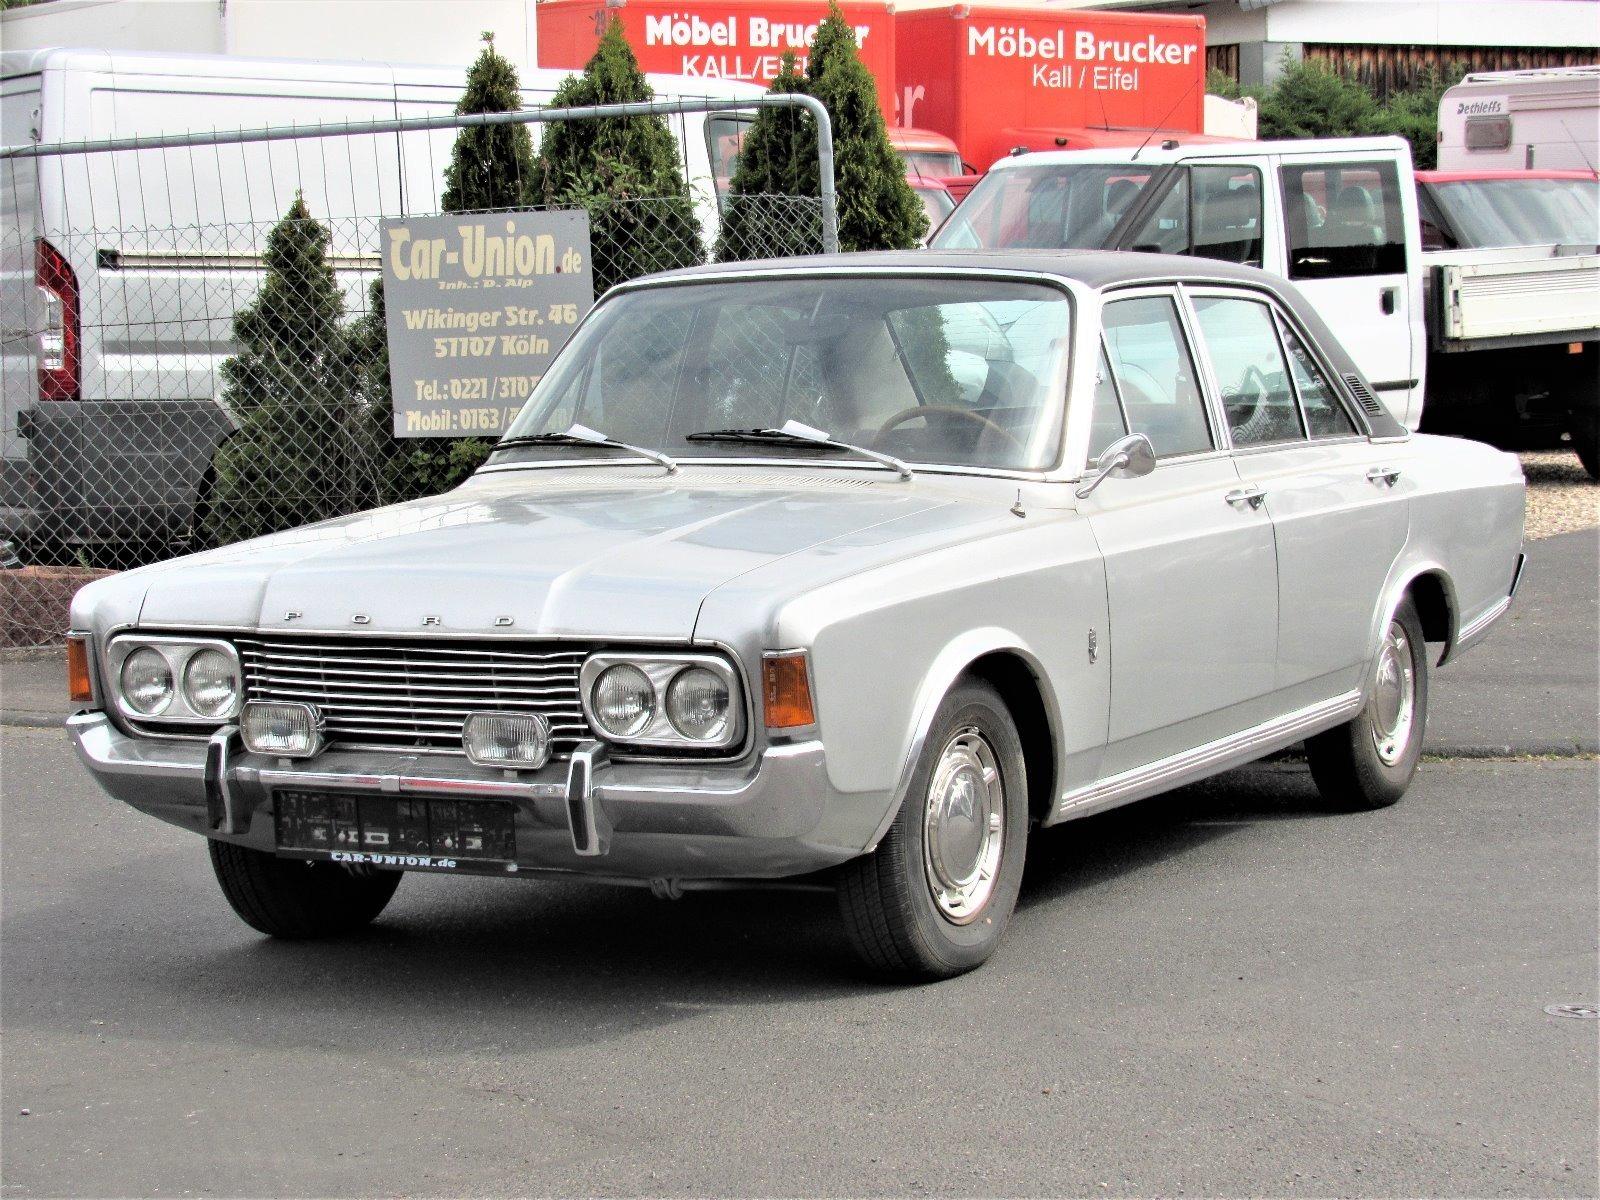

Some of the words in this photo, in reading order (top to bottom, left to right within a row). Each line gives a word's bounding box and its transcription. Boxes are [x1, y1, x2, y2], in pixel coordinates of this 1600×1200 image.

[645, 13, 736, 47] Möbel
[749, 16, 870, 50] Brucr
[967, 25, 1064, 59] Möbel
[1075, 31, 1197, 65] Brucker
[1032, 64, 1072, 88] Kall
[1093, 66, 1139, 91] Eifel
[1456, 100, 1502, 115] Dethleffs
[388, 220, 582, 281] Car-Union.de
[402, 307, 501, 332] Wikinger
[504, 305, 545, 327] Str.
[548, 303, 578, 325] 46
[434, 336, 497, 358] 51107
[501, 334, 549, 356] Köln
[284, 611, 515, 627] FORD
[331, 852, 457, 868] CAR-UNION.de
